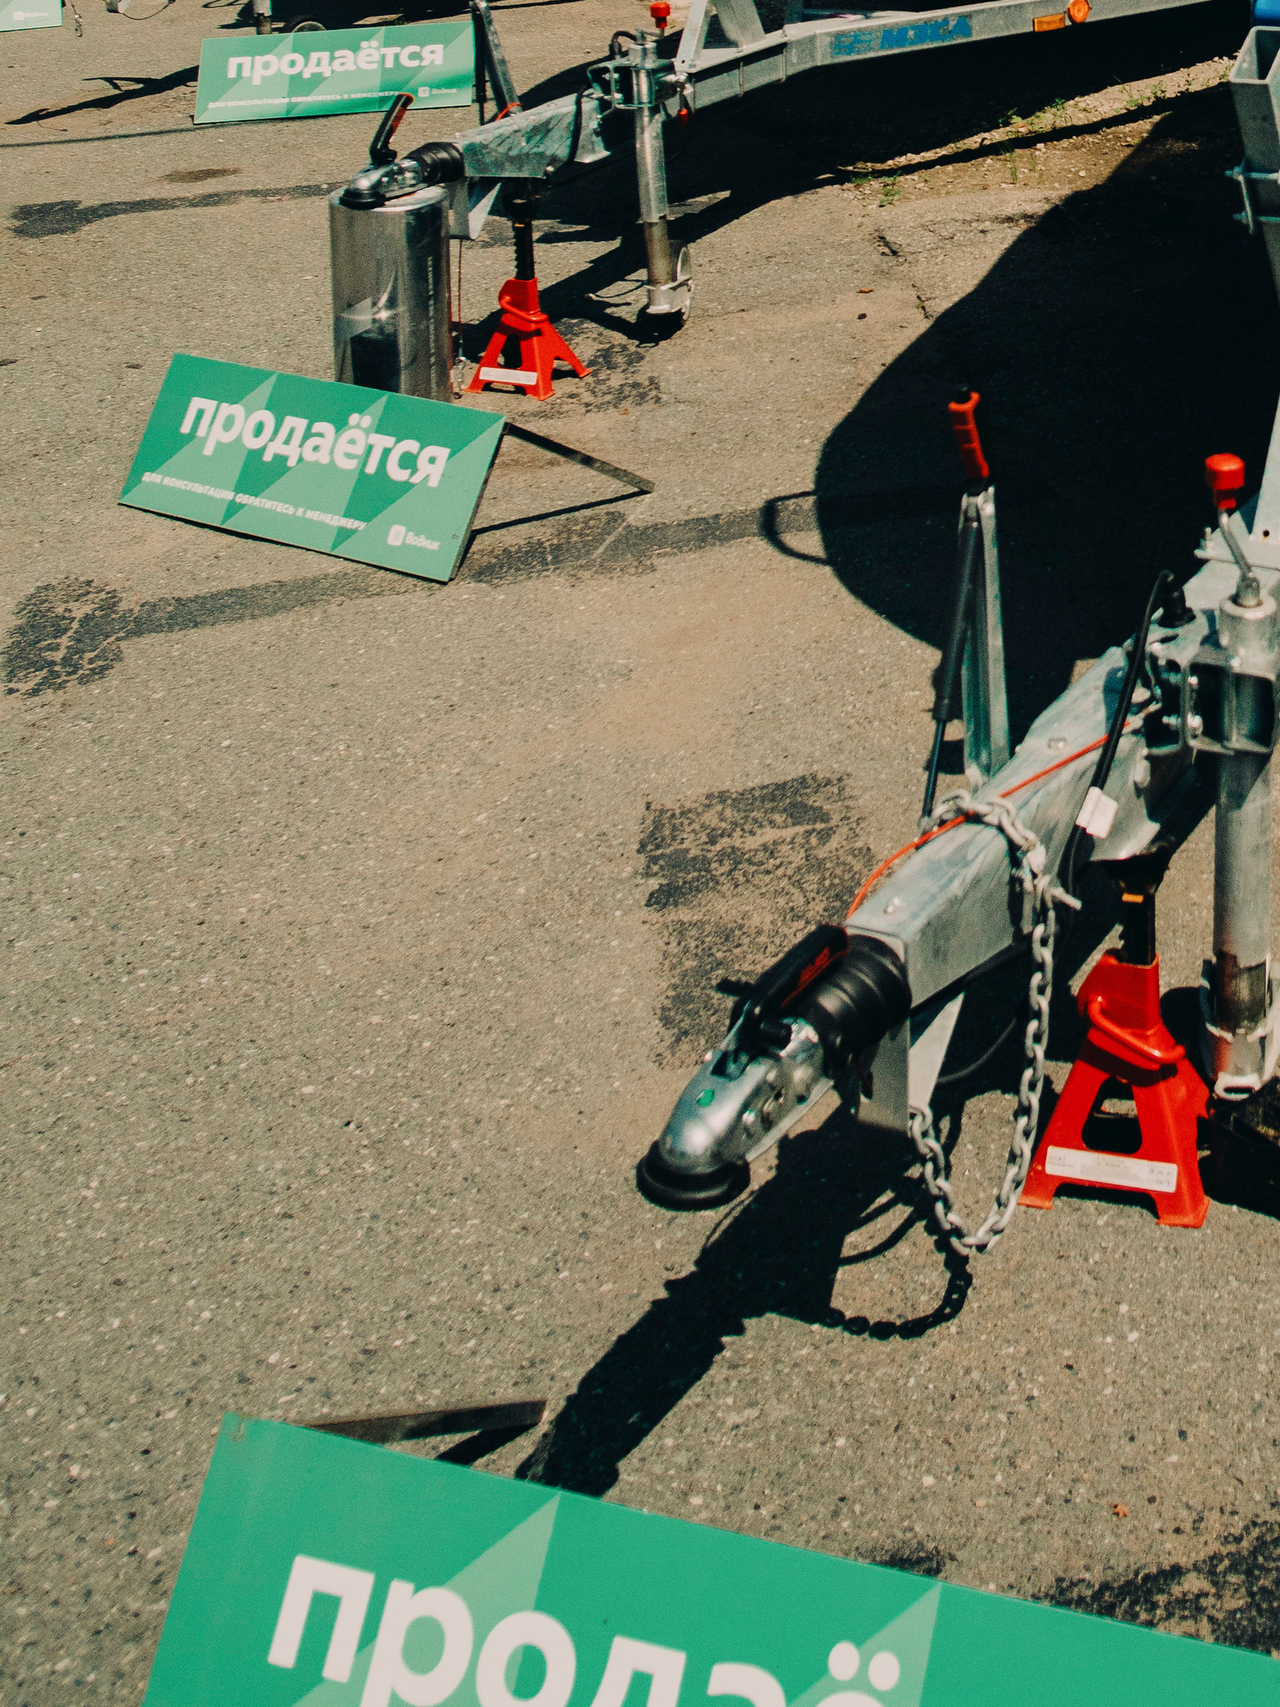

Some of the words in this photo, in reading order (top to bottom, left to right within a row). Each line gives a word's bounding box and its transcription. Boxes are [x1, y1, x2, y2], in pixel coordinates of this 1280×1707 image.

[880, 15, 972, 50] МЗСА
[227, 40, 444, 85] продаётся
[180, 397, 451, 488] продаётся
[141, 472, 162, 484] ДЛЯ
[162, 476, 235, 501] КОНСУЛЬТАЦИИ
[235, 493, 295, 515] ОБРАТИТЕСЬ
[305, 509, 367, 531] МЕНЕДЖЕРУ
